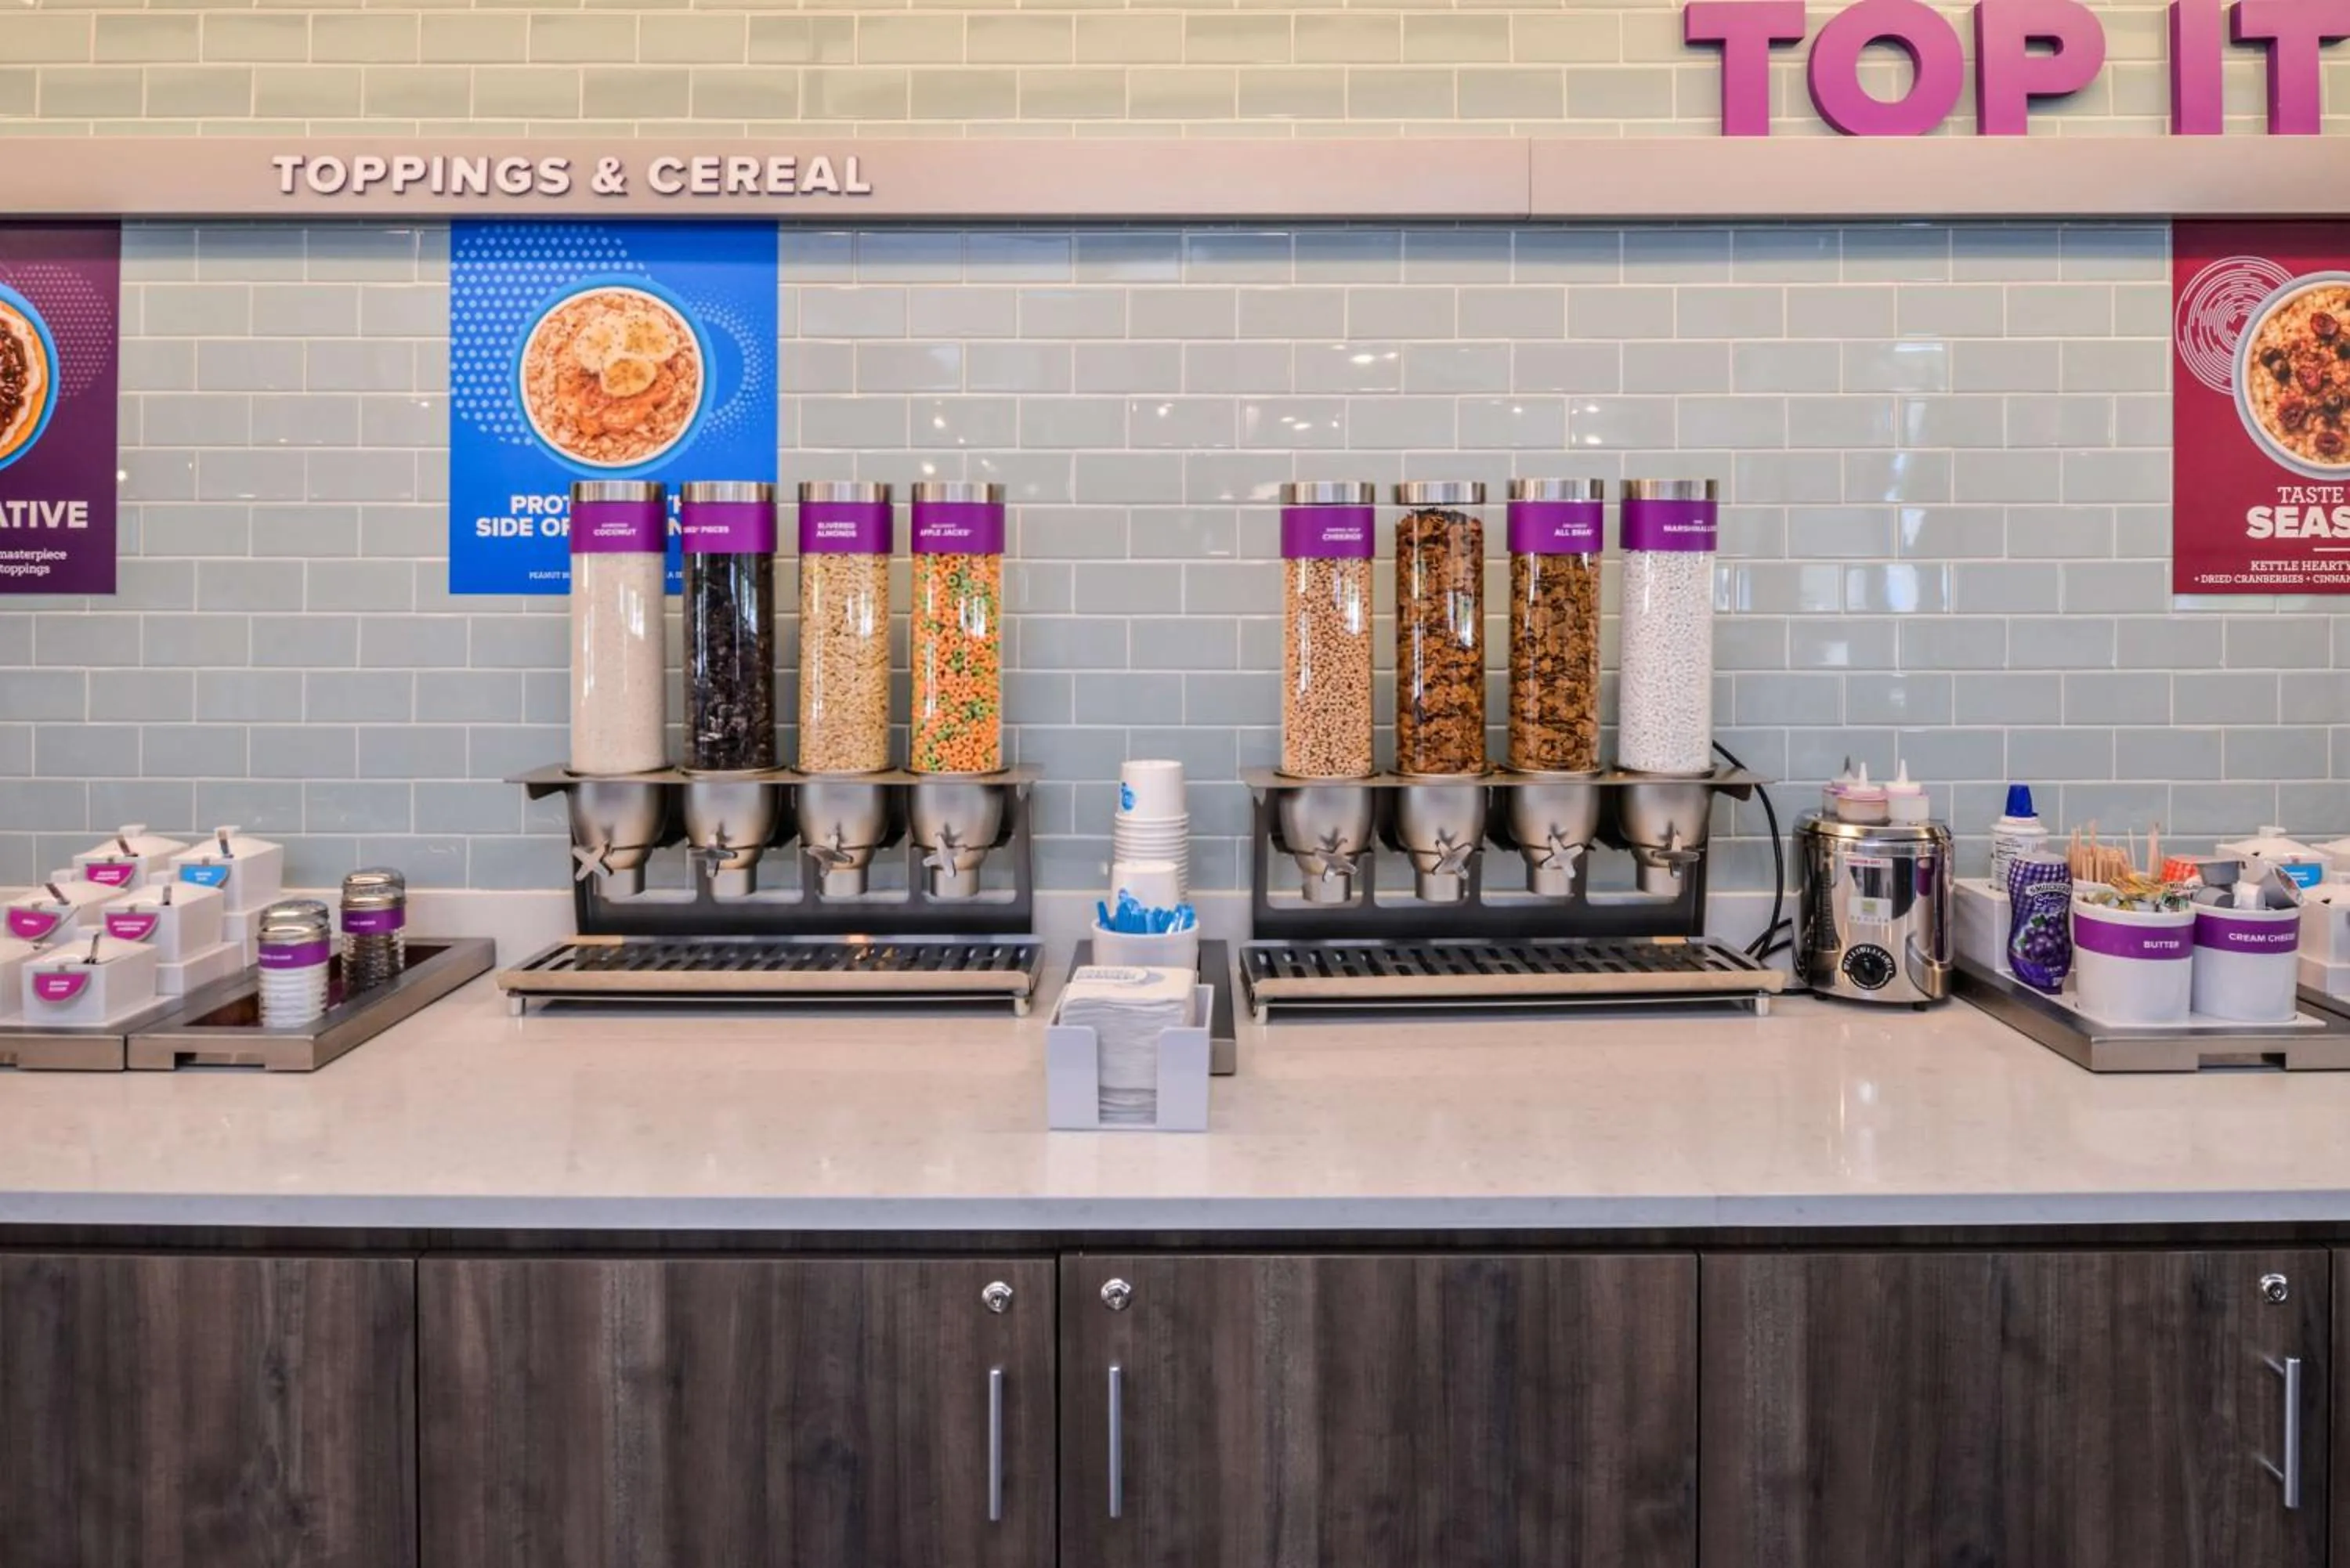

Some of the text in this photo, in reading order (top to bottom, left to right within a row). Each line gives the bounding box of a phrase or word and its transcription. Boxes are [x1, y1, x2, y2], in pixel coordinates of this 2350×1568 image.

[1685, 0, 2350, 135] TOP IT
[273, 155, 872, 196] TOPPINGS & CEREAL
[2277, 486, 2345, 504] TASTE
[475, 517, 570, 537] SIDE OF
[2246, 505, 2350, 539] SEAS
[0, 563, 50, 576] toppings
[2251, 560, 2299, 571] KETTLE
[2200, 574, 2232, 583] DRIED
[2234, 574, 2304, 583] CRANBERRIES
[2143, 940, 2180, 949] BUTTER
[2229, 933, 2266, 943] CREAM
